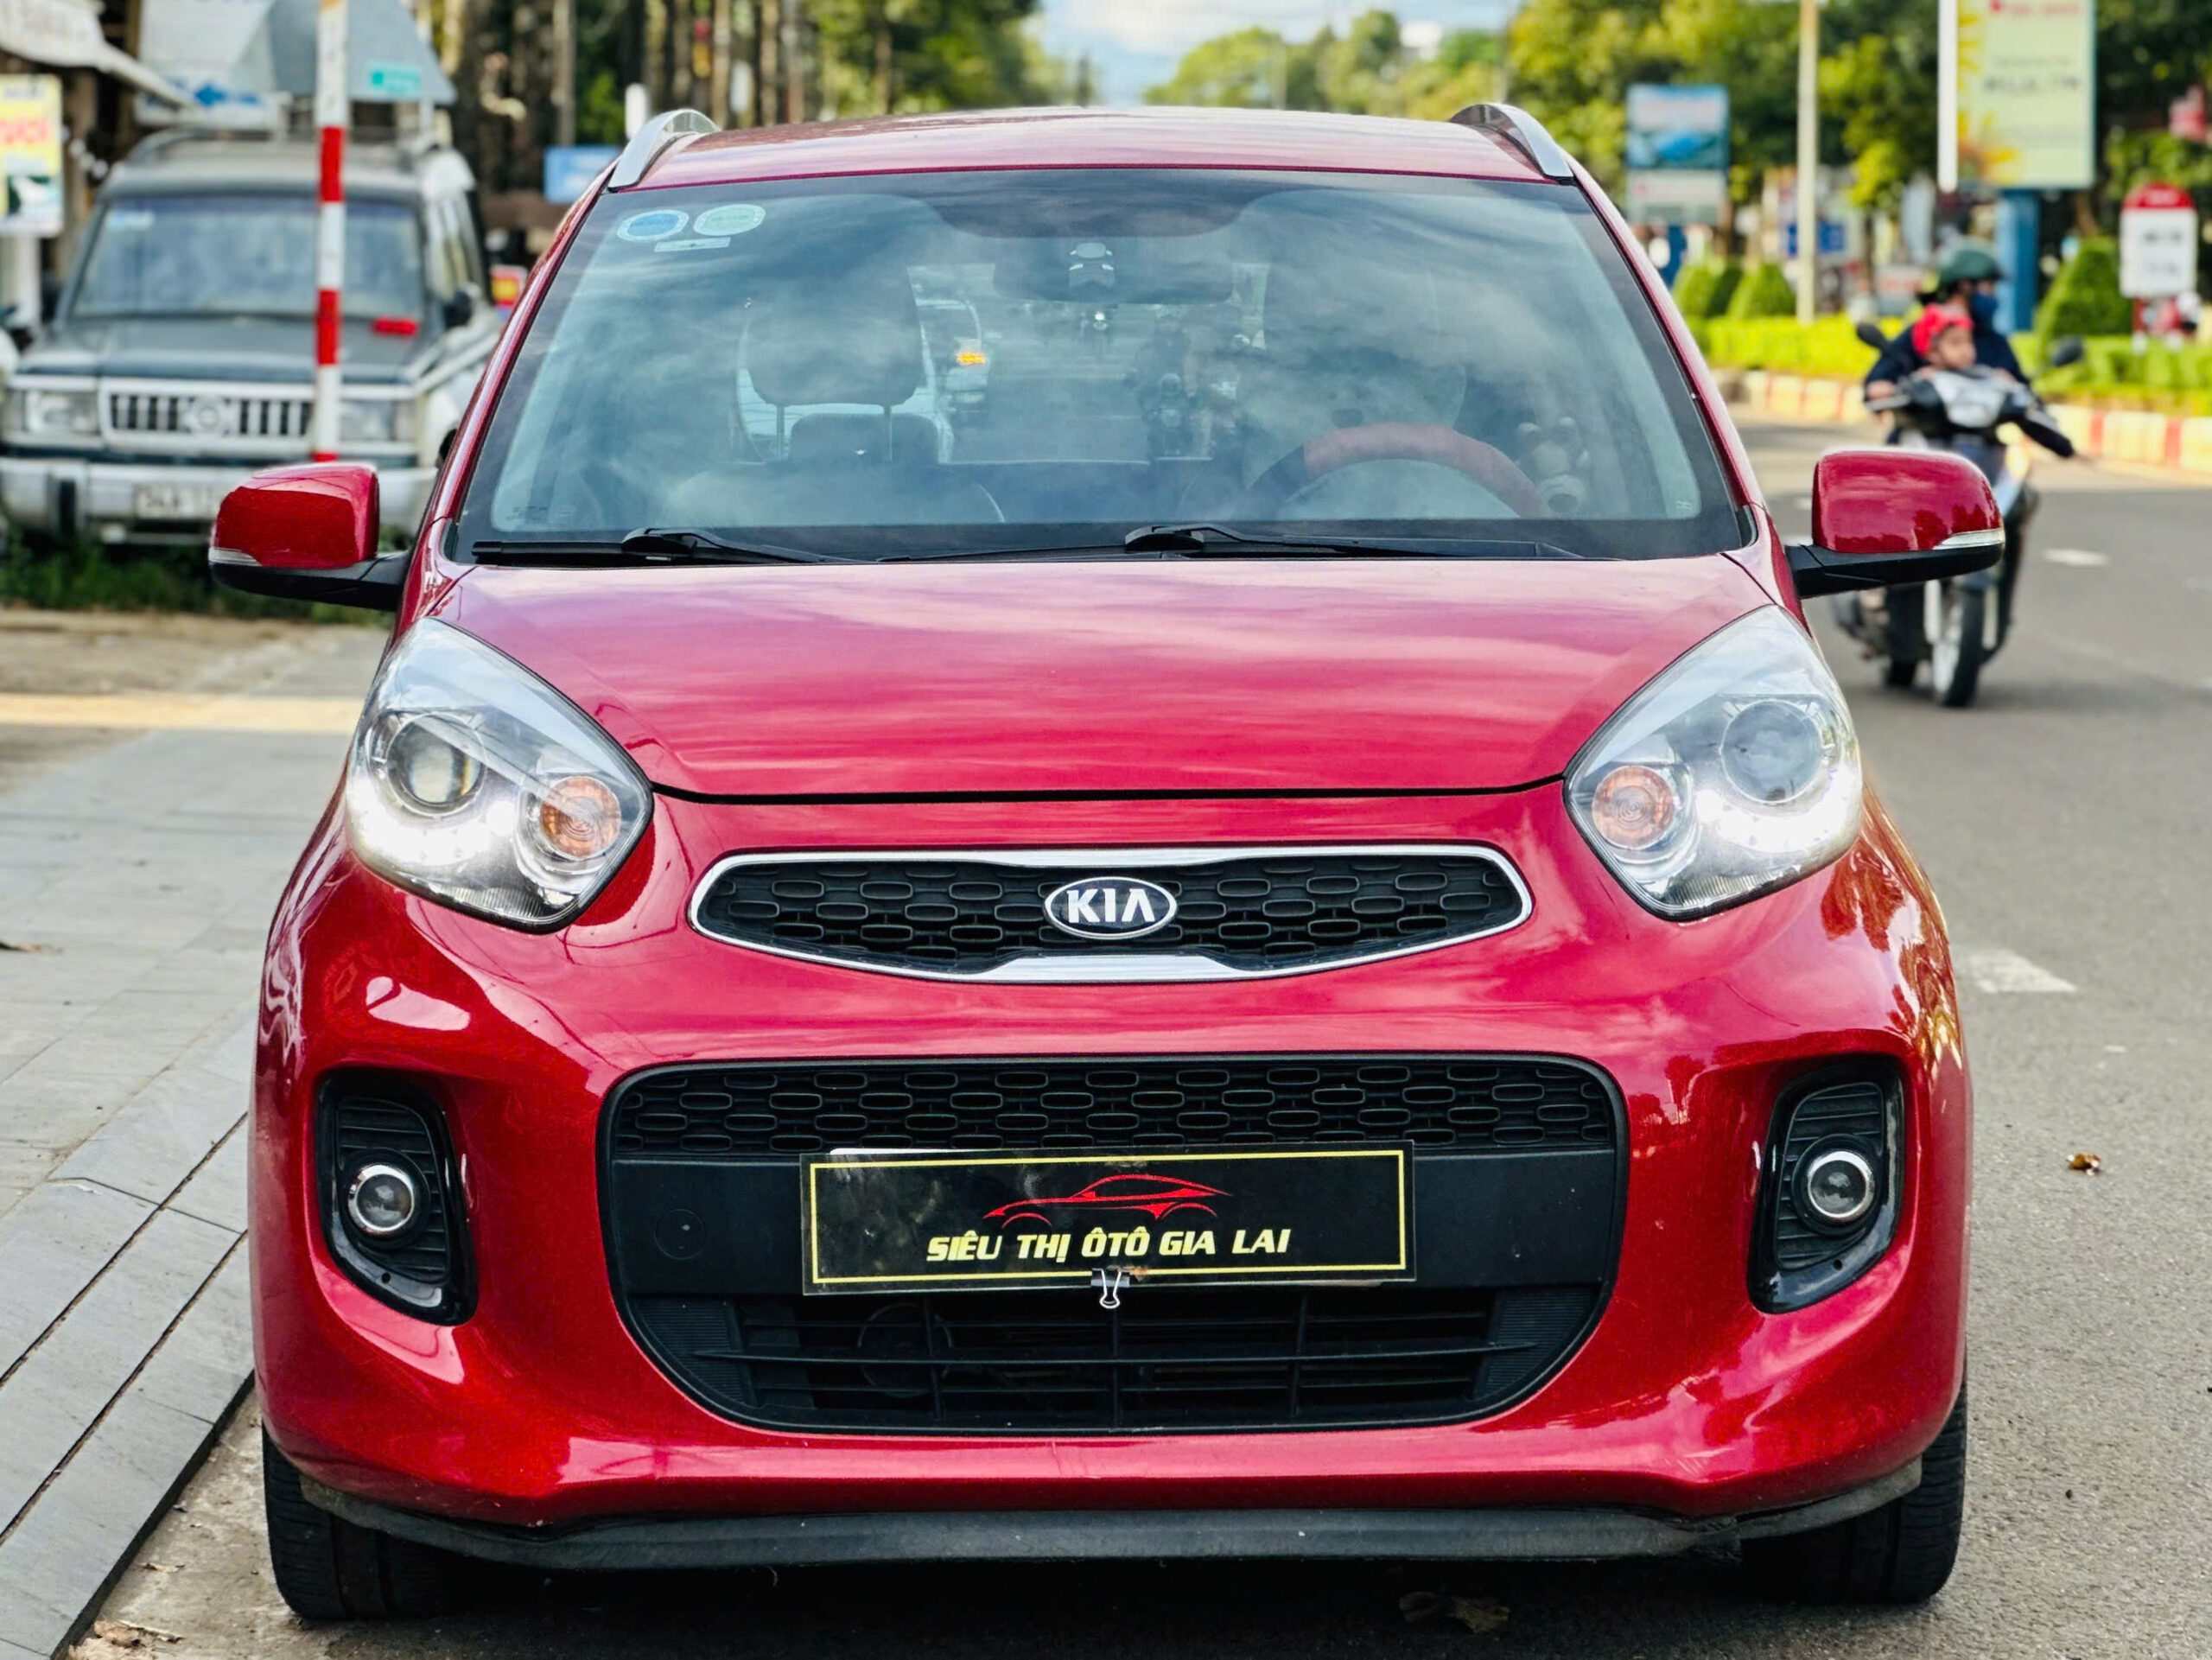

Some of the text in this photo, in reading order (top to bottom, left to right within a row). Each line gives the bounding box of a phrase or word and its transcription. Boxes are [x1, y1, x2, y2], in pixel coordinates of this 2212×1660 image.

[1066, 887, 1155, 924] KIA
[926, 1226, 1291, 1262] SIÊU THỊ ÔTÔ GIA LAI
